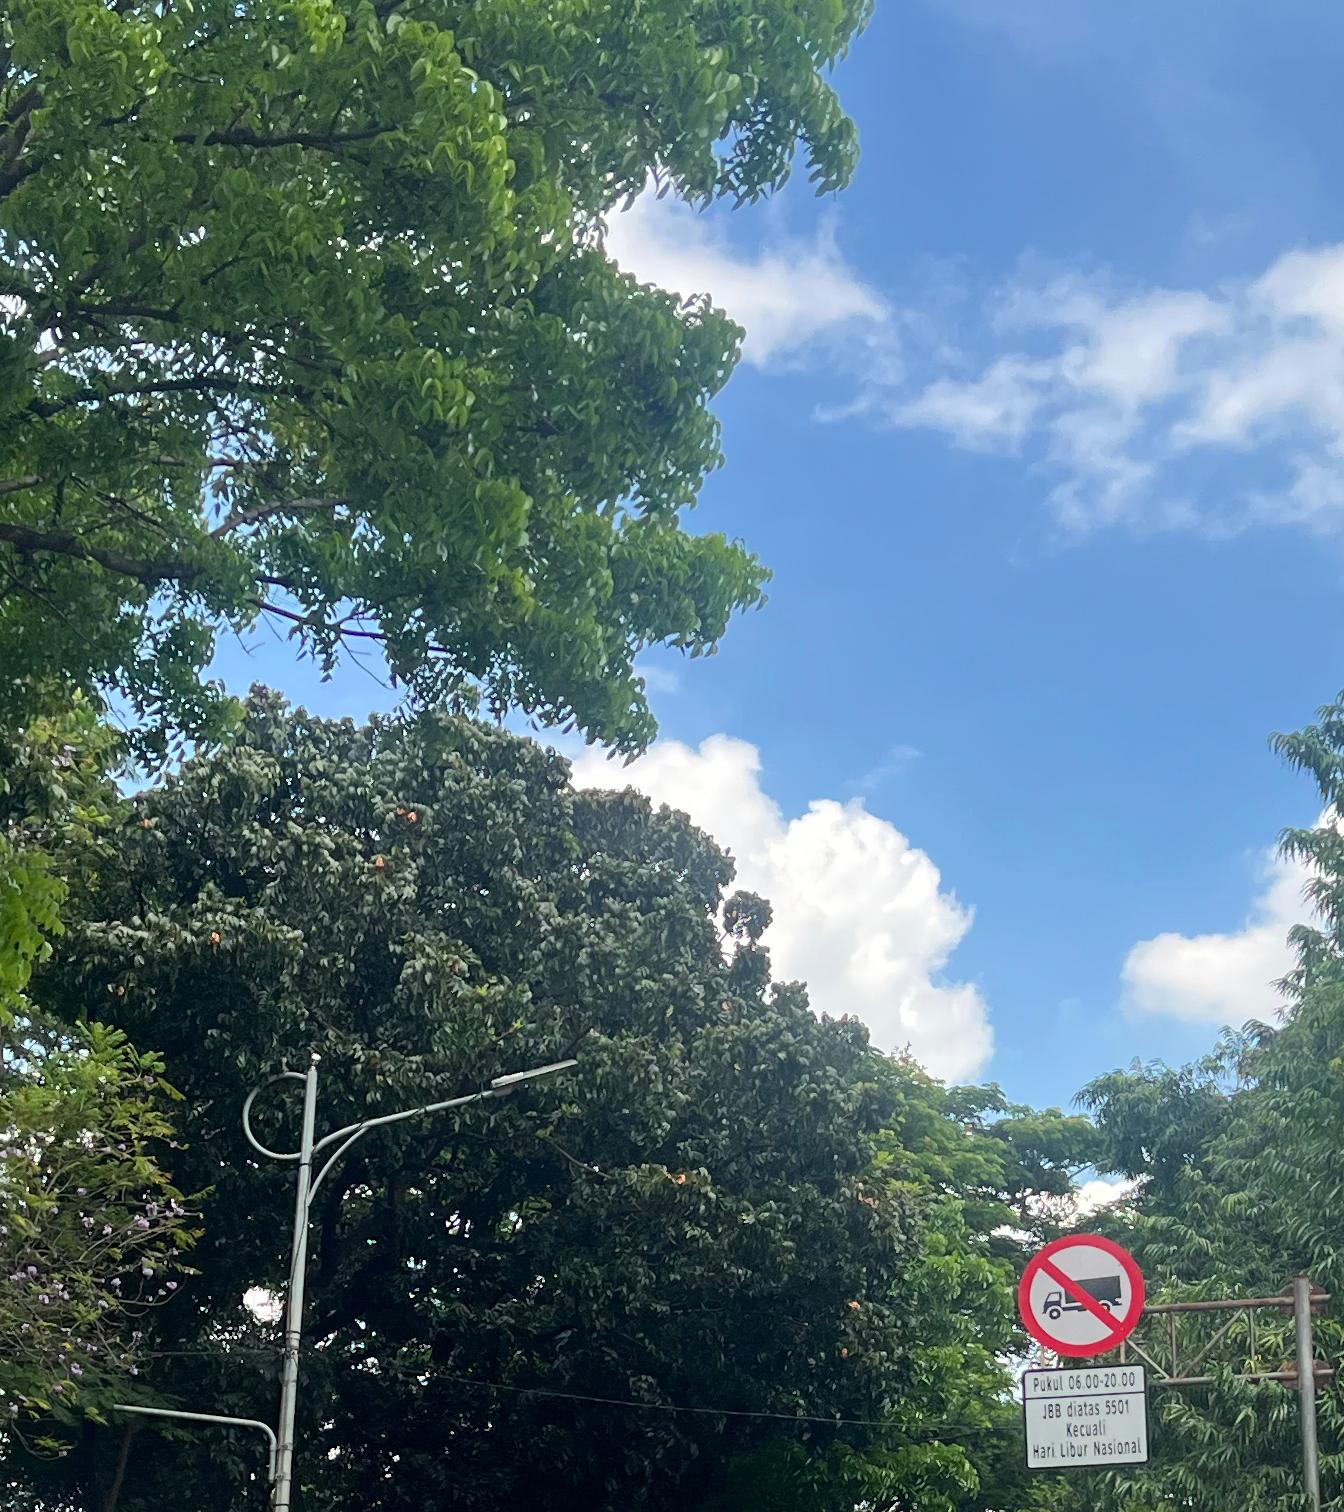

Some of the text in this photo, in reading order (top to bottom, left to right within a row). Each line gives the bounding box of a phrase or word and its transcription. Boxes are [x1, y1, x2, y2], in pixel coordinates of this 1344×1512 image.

[1033, 1372, 1135, 1392] Pukul 06.00-20.00
[1043, 1400, 1129, 1419] JBB diatas 5501
[1066, 1420, 1106, 1437] Kecuali
[1033, 1437, 1142, 1459] Hari Libur Nasional
